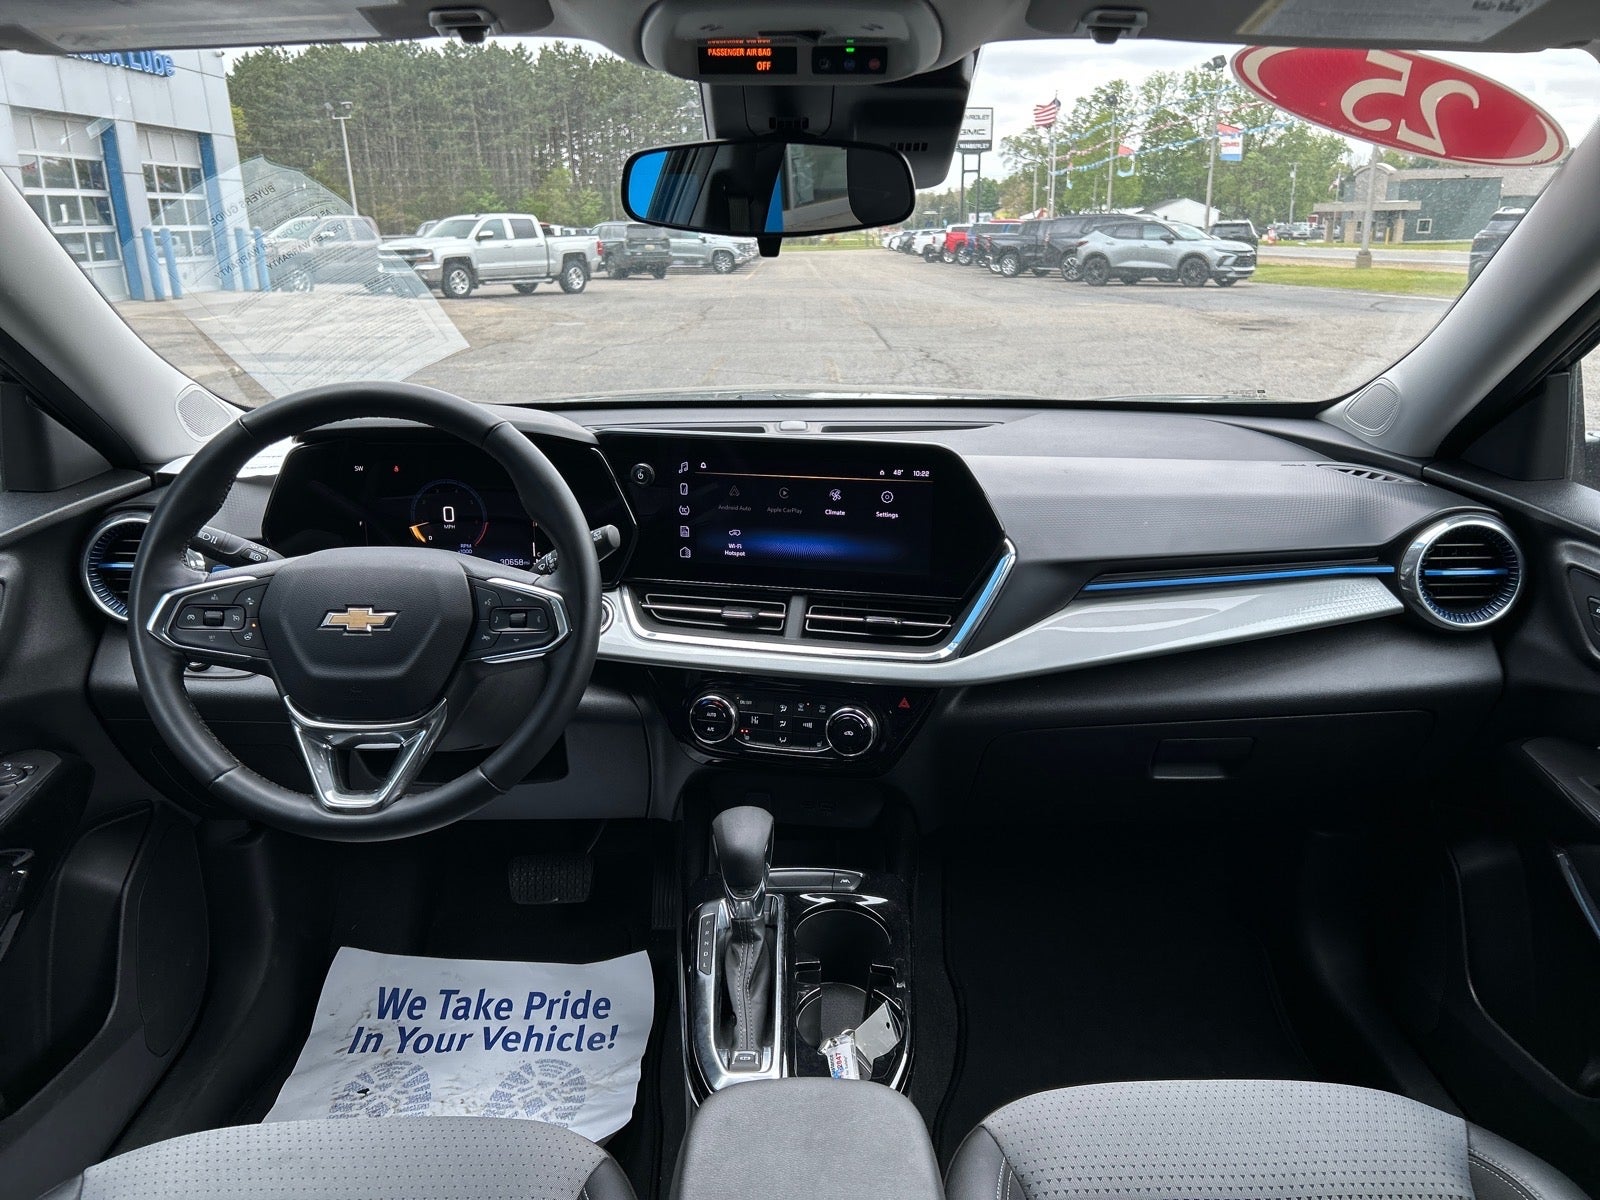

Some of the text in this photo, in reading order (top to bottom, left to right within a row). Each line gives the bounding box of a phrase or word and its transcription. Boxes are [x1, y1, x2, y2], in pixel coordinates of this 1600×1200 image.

[708, 48, 772, 57] PASSENGER AIR BAG
[127, 50, 175, 77] Lube
[757, 61, 771, 71] OFF
[442, 505, 455, 522] 0
[784, 507, 802, 515] CarPlay
[876, 511, 898, 519] Settings
[499, 558, 524, 566] 30658
[376, 987, 612, 1021] We Take Pride
[348, 1024, 619, 1054] In Your Vehicle!
